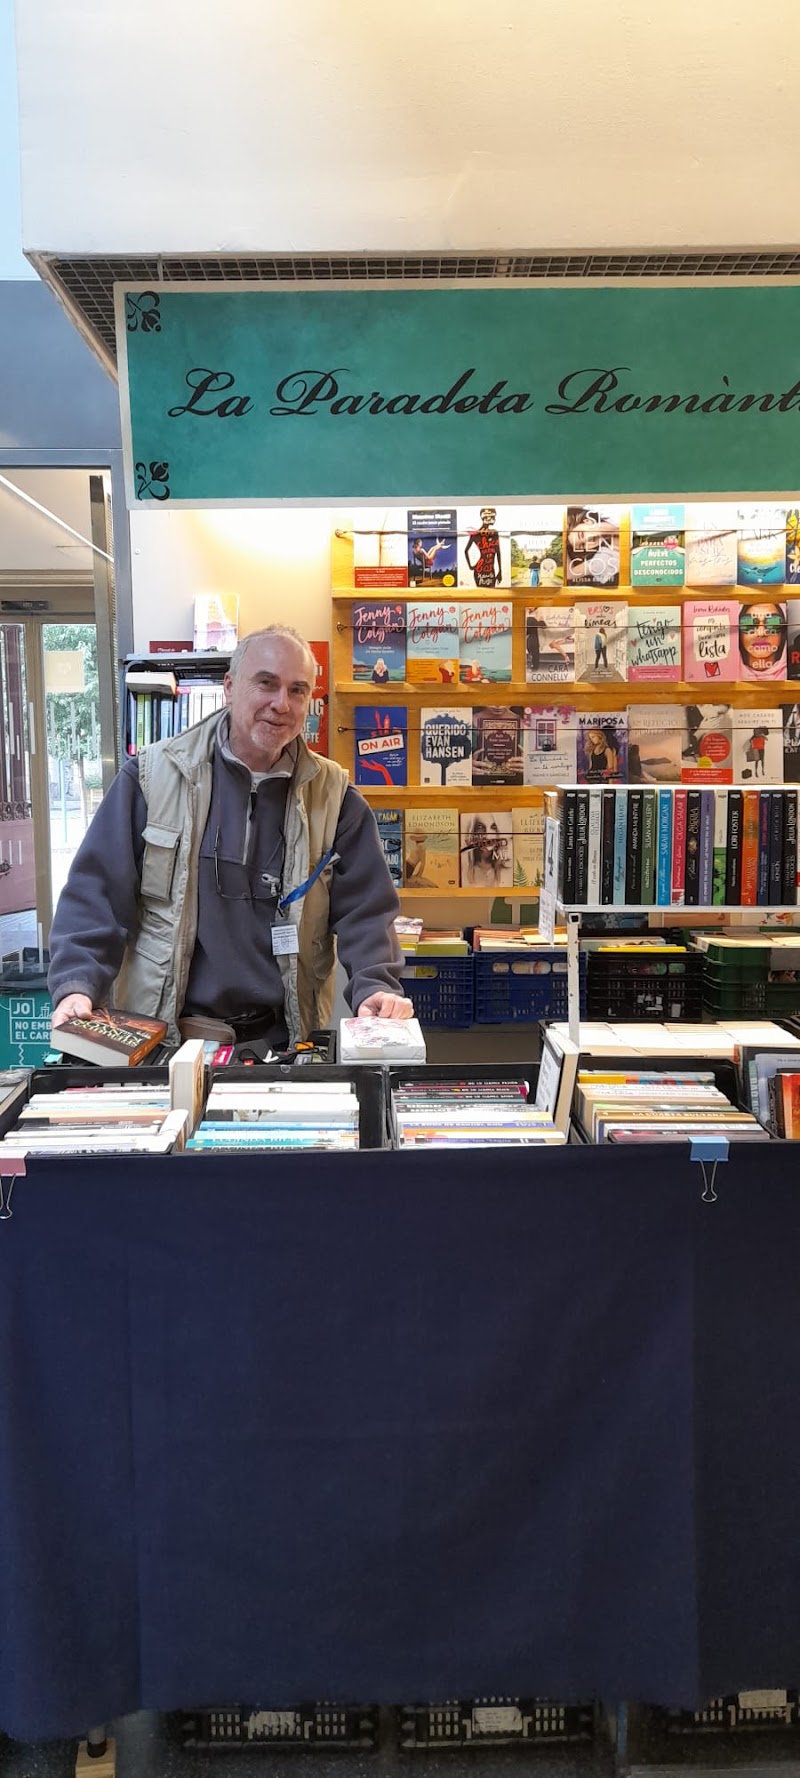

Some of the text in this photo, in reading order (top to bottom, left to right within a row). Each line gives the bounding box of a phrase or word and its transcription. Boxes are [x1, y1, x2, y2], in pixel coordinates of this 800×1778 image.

[168, 368, 254, 417] La
[270, 368, 534, 416] Paradeta
[573, 533, 615, 552] LEN
[648, 551, 669, 559] NUEVE
[569, 557, 618, 576] CIOS
[354, 605, 397, 627] Jenny
[408, 606, 449, 627] Jenny
[461, 605, 503, 627] Jenny
[358, 618, 405, 644] Colgan
[412, 618, 459, 644] Colgan
[464, 618, 511, 644] Colgan
[698, 640, 726, 658] lista
[548, 664, 569, 673] CARA
[752, 658, 773, 669] ella
[531, 673, 569, 682] CONNELLY
[425, 723, 467, 736] QUERIDO
[579, 717, 625, 726] MARIPOSA
[361, 737, 402, 752] ON AIR
[426, 736, 451, 747] EVAN
[426, 746, 465, 759] HANSEN
[577, 803, 588, 826] LONDON
[661, 804, 669, 833] MORGAN
[731, 810, 739, 834] FOSTER
[786, 803, 796, 826] LONDON
[661, 834, 669, 855] SARAH
[13, 1002, 30, 1015] JO
[15, 1021, 52, 1030] NO EMB
[15, 1031, 52, 1040] EL CAR
